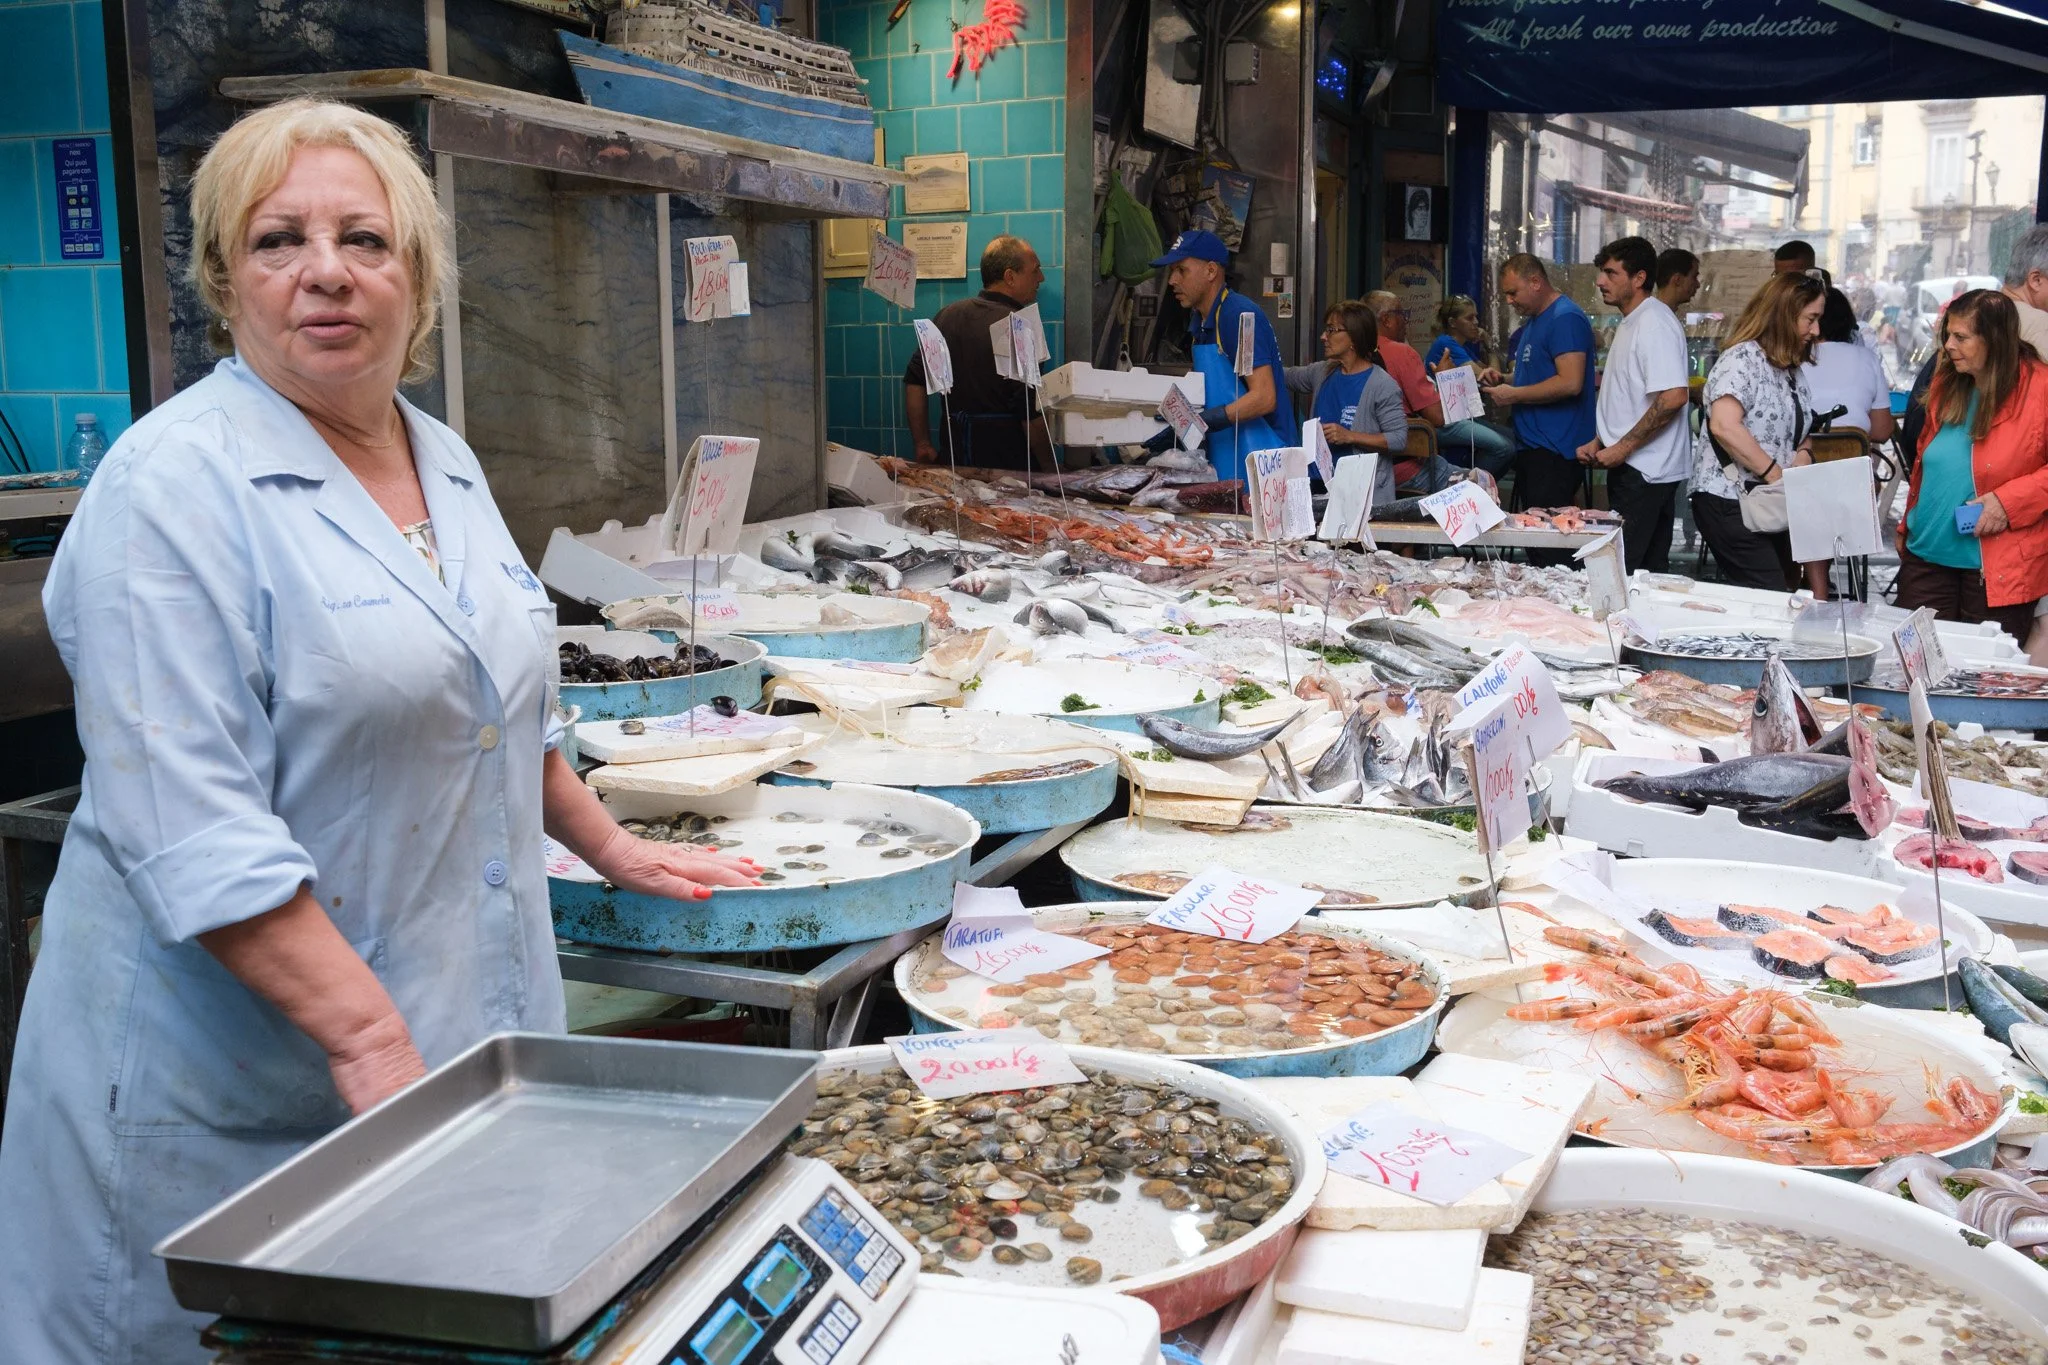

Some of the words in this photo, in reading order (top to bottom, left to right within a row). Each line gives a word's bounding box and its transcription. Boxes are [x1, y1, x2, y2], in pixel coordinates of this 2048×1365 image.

[1467, 17, 1516, 44] All
[1520, 15, 1585, 50] fresh
[1592, 24, 1634, 41] our
[1643, 23, 1692, 39] own
[1699, 14, 1838, 43] production
[65, 159, 75, 168] Qui
[75, 158, 88, 168] puoi
[62, 169, 81, 177] pagare
[1257, 450, 1282, 477] ORATE
